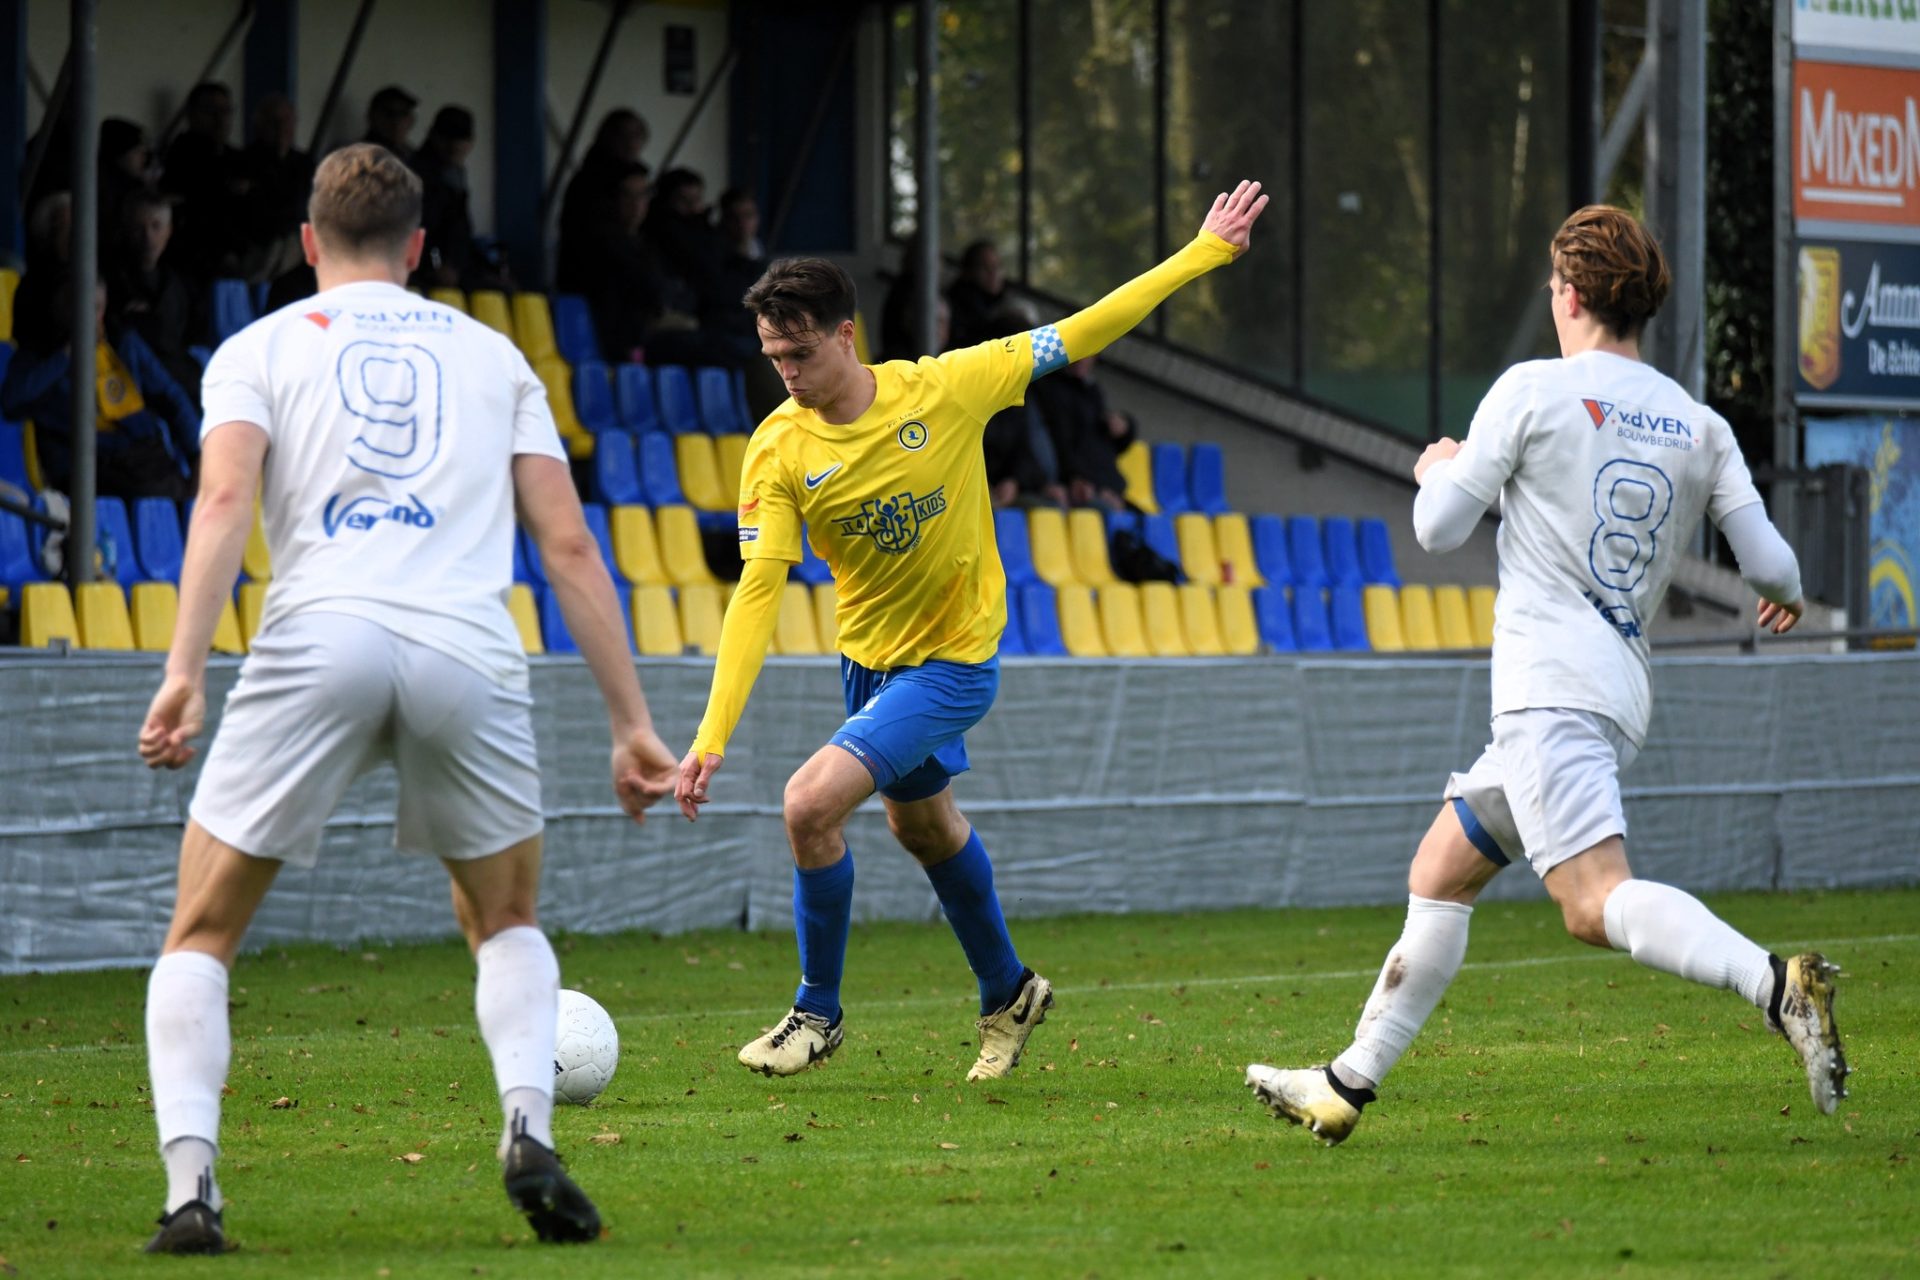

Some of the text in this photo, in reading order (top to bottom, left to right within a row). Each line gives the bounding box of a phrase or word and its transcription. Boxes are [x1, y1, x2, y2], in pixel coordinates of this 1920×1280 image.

[1868, 338, 1887, 375] De
[337, 341, 441, 480] 9
[1616, 426, 1694, 452] BOUWBEDRIJF
[916, 491, 946, 519] KIDS
[1589, 458, 1673, 592] 8
